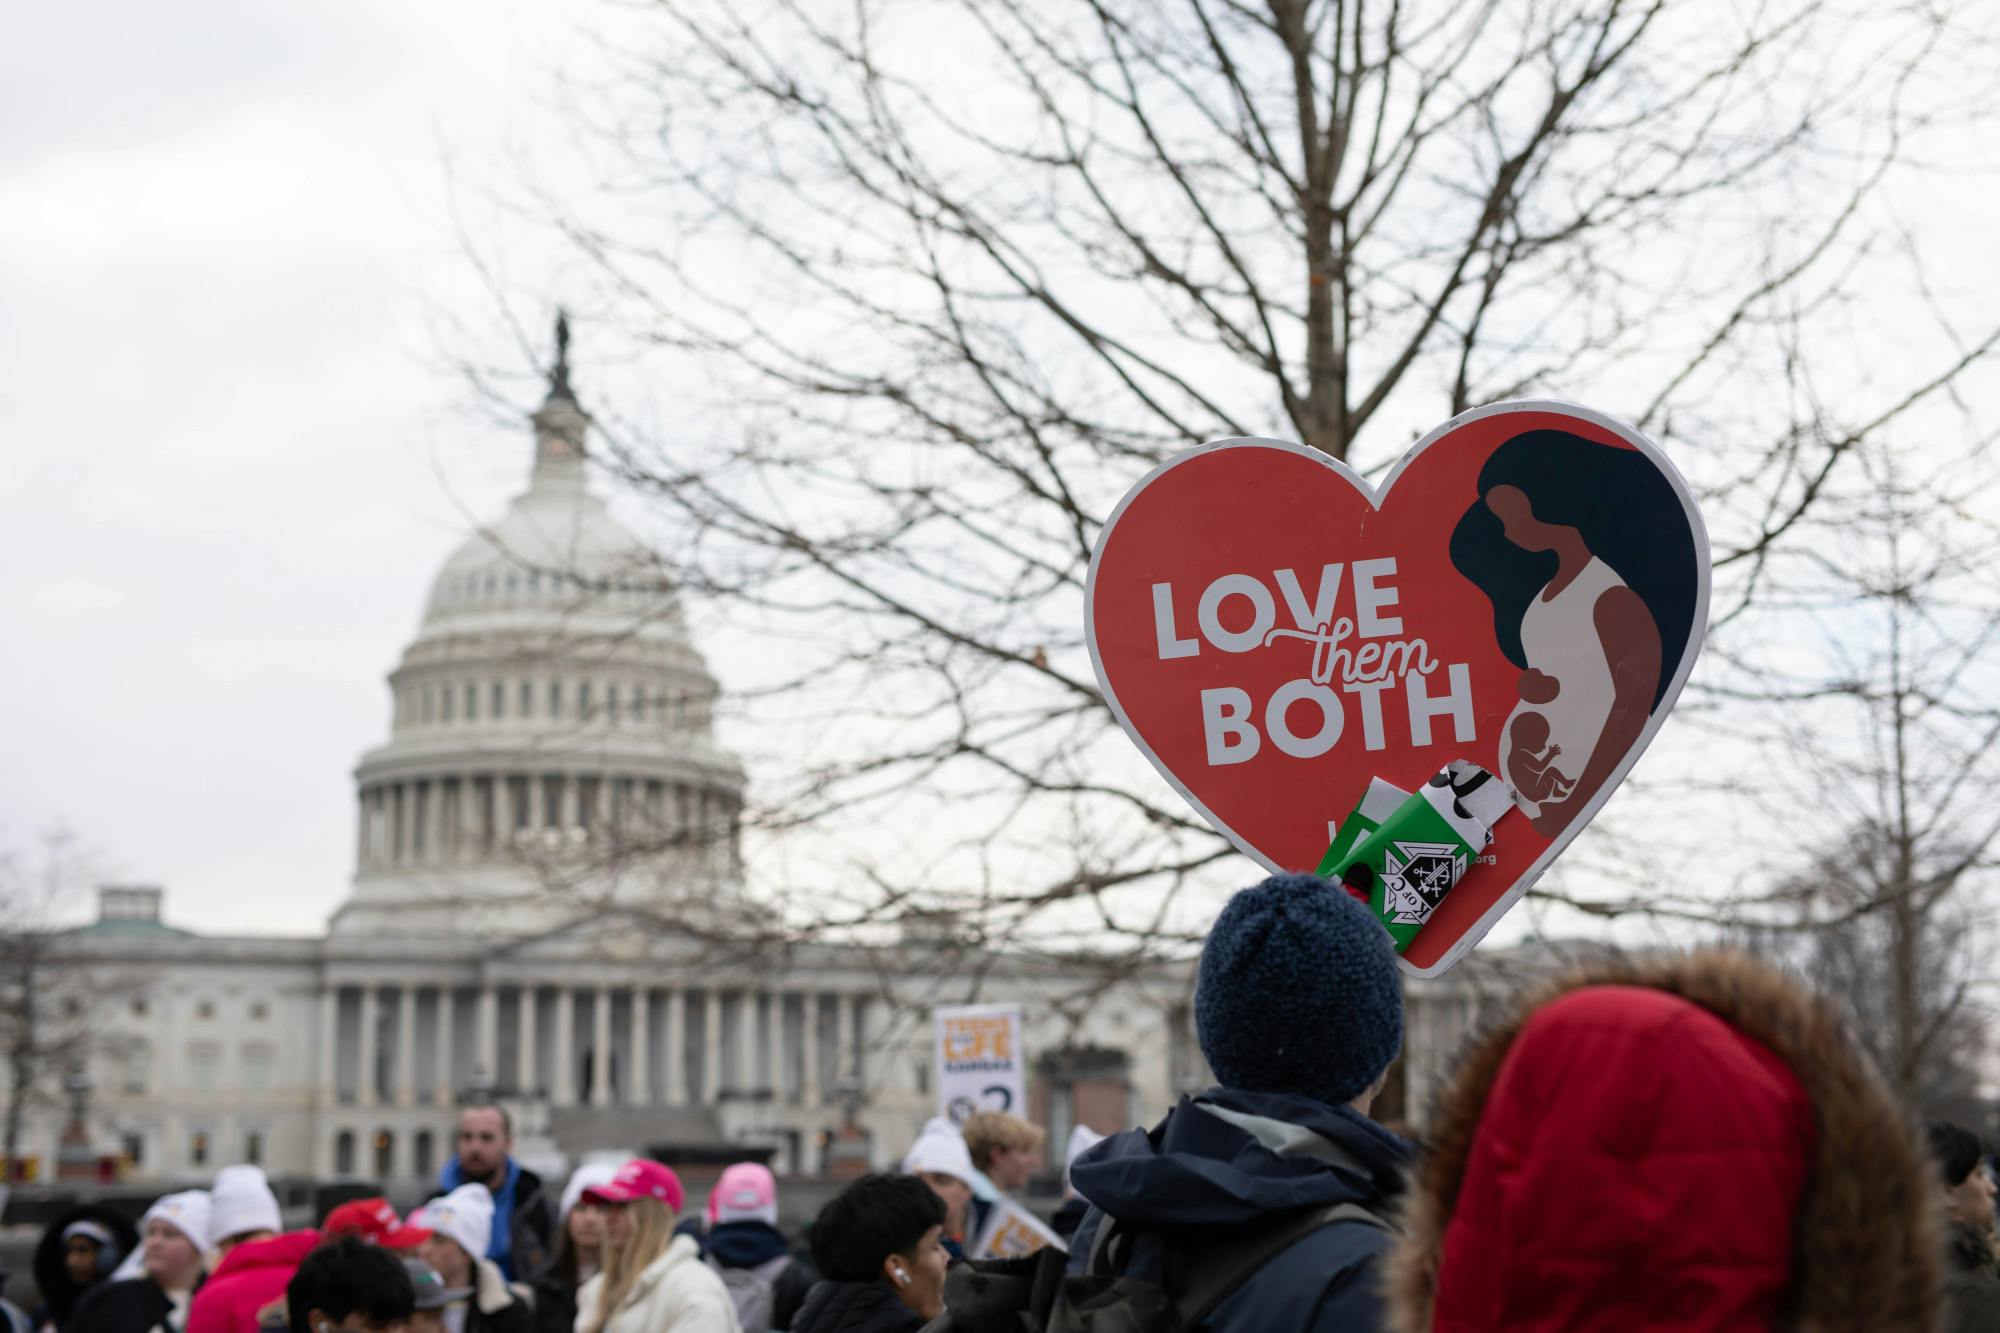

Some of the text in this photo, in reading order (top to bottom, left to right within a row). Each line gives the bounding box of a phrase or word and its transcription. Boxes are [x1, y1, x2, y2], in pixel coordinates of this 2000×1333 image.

[1152, 557, 1403, 659] LOVE
[1265, 617, 1438, 684] them
[1201, 663, 1476, 766] BOTH
[1391, 877, 1431, 919] K OF C
